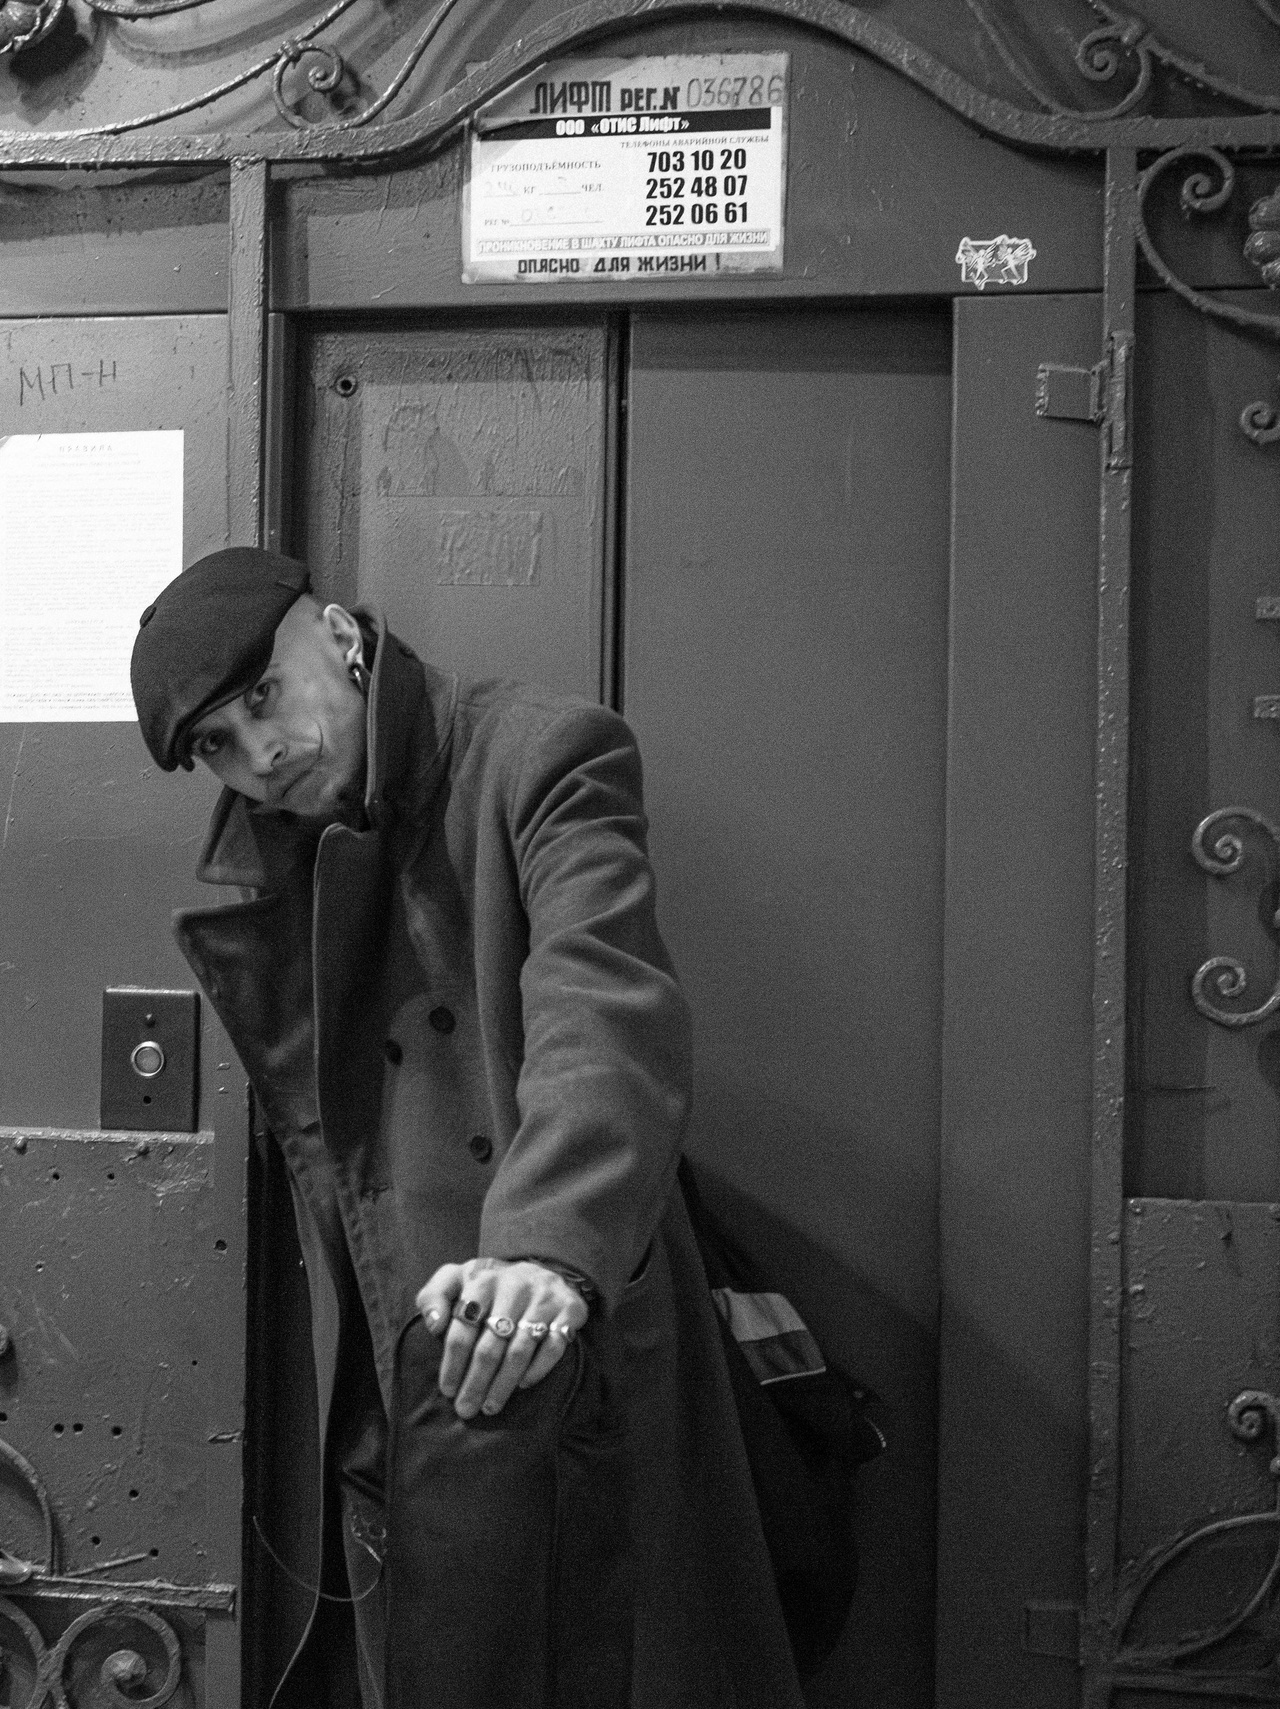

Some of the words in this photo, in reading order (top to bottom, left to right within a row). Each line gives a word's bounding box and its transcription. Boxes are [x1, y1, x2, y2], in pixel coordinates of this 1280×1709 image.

[530, 81, 612, 114] ЛИФТ
[686, 74, 783, 108] 036786
[647, 150, 685, 172] 703
[690, 150, 714, 171] 10
[720, 148, 747, 170] 20
[646, 177, 685, 199] 252
[690, 176, 718, 197] 48
[723, 175, 748, 196] 07
[646, 204, 685, 226] 252
[691, 203, 718, 224] 06
[724, 202, 748, 223] 61
[581, 236, 619, 248] ШАХТУ
[620, 234, 657, 247] ЛИФТА
[657, 232, 704, 245] ОПАСНО
[705, 231, 728, 244] ДЛЯ
[730, 230, 768, 243] ЖИЗНИ
[593, 257, 630, 273] ДЛЯ
[637, 255, 707, 272] ЖИЗНИ
